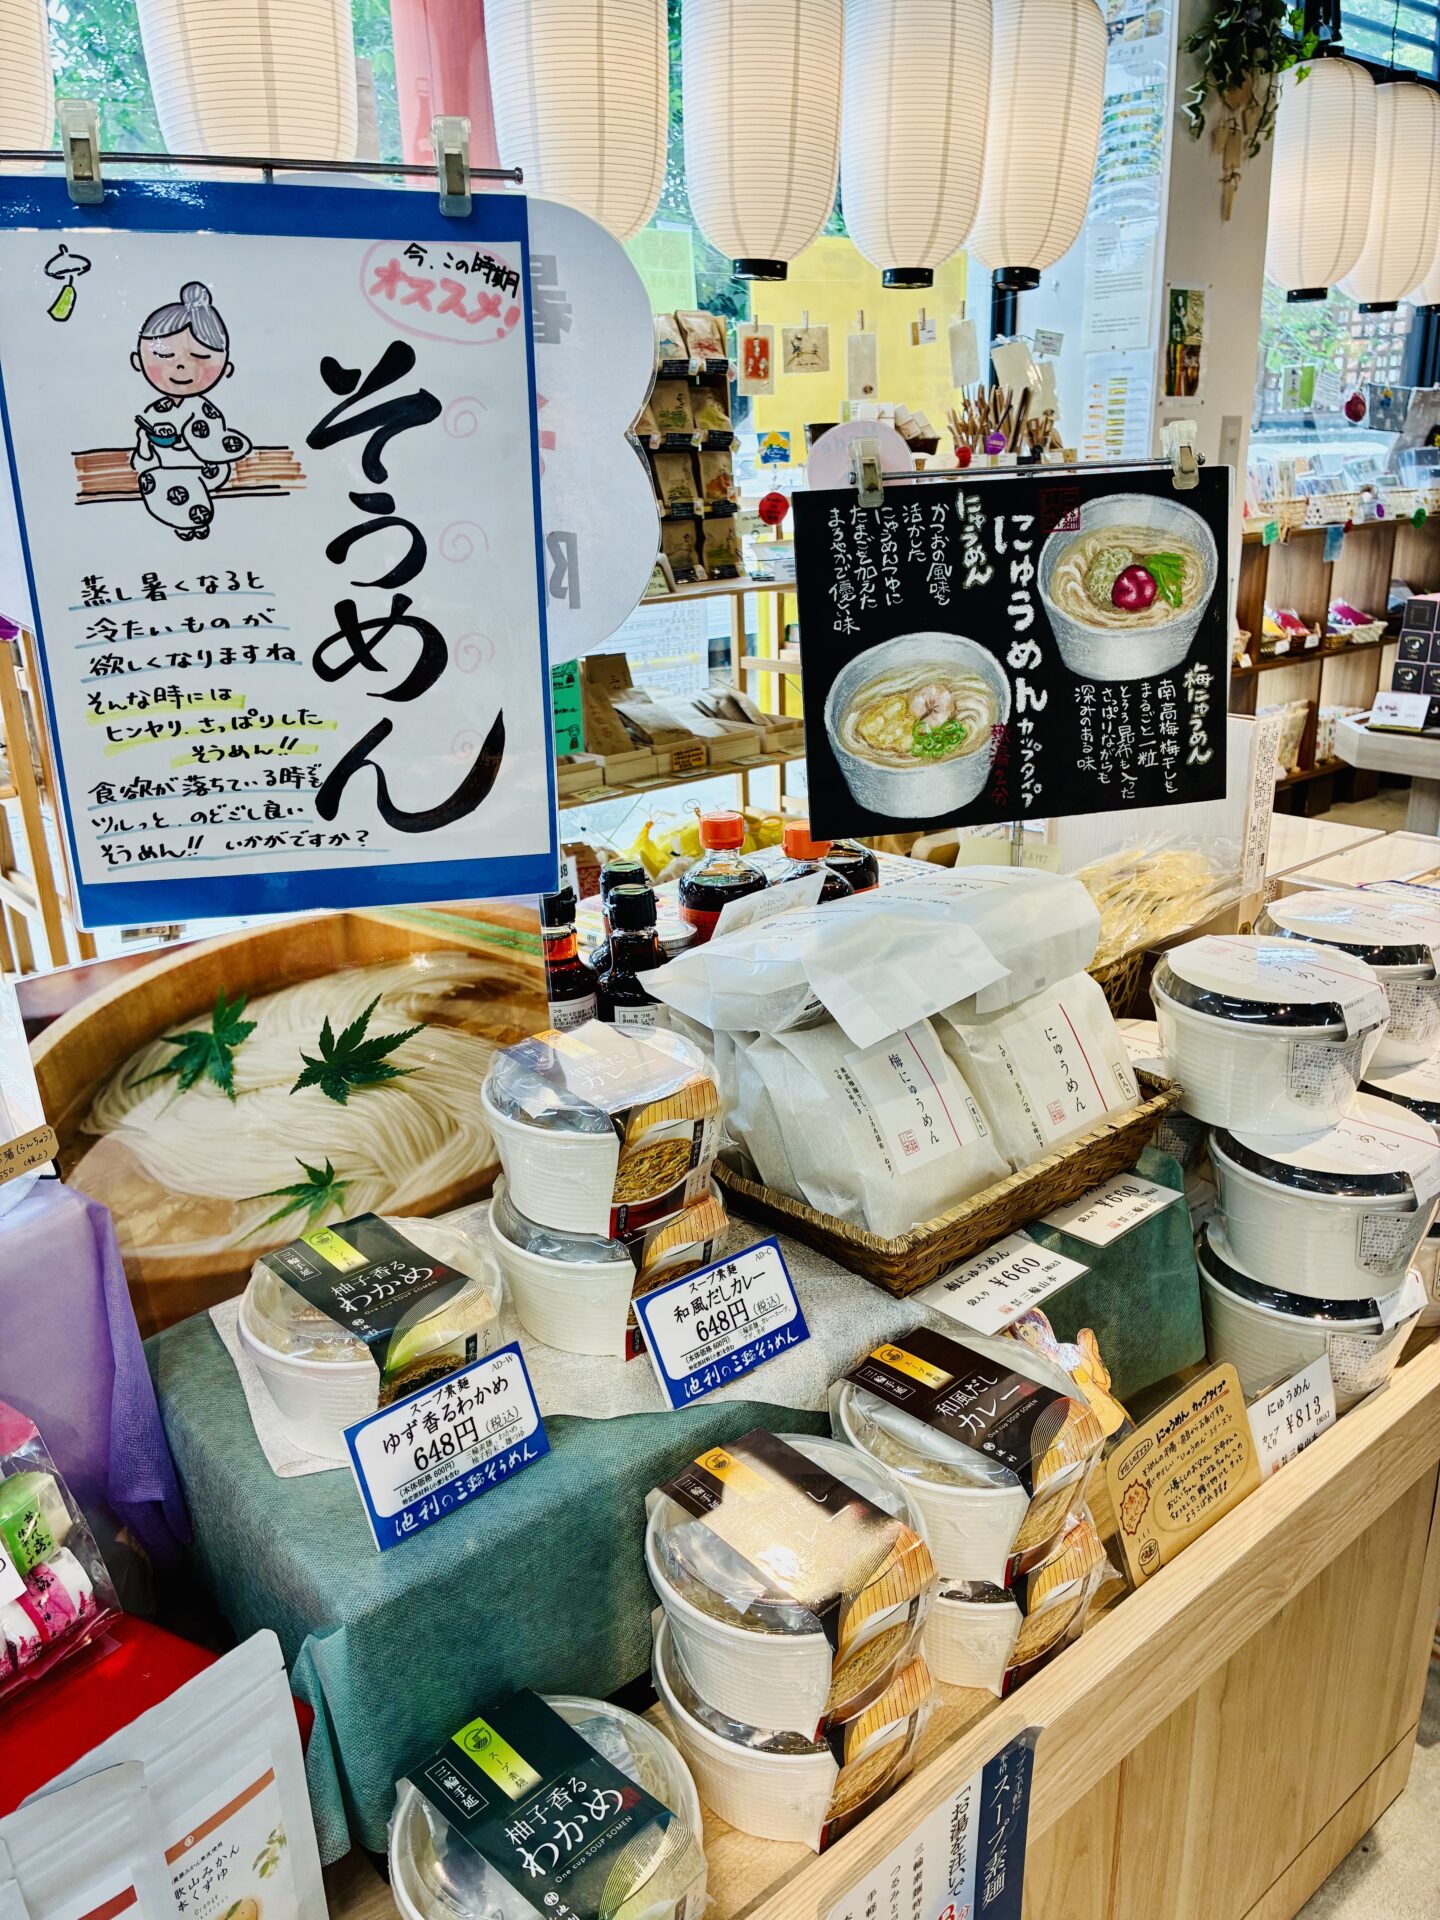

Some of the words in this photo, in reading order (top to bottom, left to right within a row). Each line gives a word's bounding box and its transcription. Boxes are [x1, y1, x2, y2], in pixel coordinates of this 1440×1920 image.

[850, 504, 878, 609] たまごを加えた
[874, 506, 903, 605] にゅうめんつゆに
[902, 503, 926, 562] 活かした
[926, 503, 952, 605] かつおの風味を
[957, 489, 994, 589] にゅうめん
[81, 571, 265, 607] 蒸し暑くなると
[306, 340, 505, 833] そうめん
[828, 508, 860, 634] まろやかで優しい味
[85, 608, 276, 642] 冷たいものが
[994, 516, 1047, 713] にゅうめん
[90, 643, 296, 677] 欲しくなりますね
[87, 685, 232, 716] そんな時には
[1075, 684, 1097, 771] 深みのある味
[1137, 682, 1158, 767] まるごと一粒
[1183, 662, 1215, 766] 梅にゅうめん
[1016, 718, 1042, 808] カップタイプ
[1097, 688, 1119, 784] さっぱりながらも
[1115, 686, 1138, 799] とろろ昆布も入った
[89, 764, 324, 804] 食欲が落ちている時でも
[226, 830, 370, 852] いかがですか?
[888, 1054, 940, 1145] 梅にゅうめん
[1044, 1027, 1085, 1112] にゅうめん
[1094, 1184, 1140, 1210] ¥660
[332, 1261, 406, 1298] 柚子香る
[689, 1262, 738, 1294] スープ素麺
[755, 1247, 773, 1262] AD-C
[943, 1250, 1010, 1293] 梅にゅうめん
[988, 1256, 1041, 1289] ¥660
[340, 1267, 434, 1313] わかめ
[674, 1271, 766, 1324] 和風だしカレー
[696, 1298, 750, 1342] 648円
[753, 1293, 781, 1316] (税込)
[491, 1353, 515, 1373] AD-W
[684, 1326, 800, 1398] 池利の三輪そうめん
[382, 1375, 509, 1455] ゆず香るわかめ
[410, 1375, 471, 1416] スープ素麺
[935, 1374, 998, 1417] 和風だし
[957, 1384, 1021, 1436] カレー
[1156, 1410, 1190, 1444] にゅうめん
[1191, 1379, 1226, 1412] カップタイプ
[1267, 1378, 1310, 1416] にゅうめん
[1286, 1395, 1321, 1434] ¥813
[413, 1417, 480, 1471] 648円
[485, 1405, 519, 1434] (税込)
[395, 1441, 538, 1537] 池利の三輪そうめん
[434, 1765, 480, 1811] 三輪手延
[489, 1751, 529, 1790] スープ素麺
[504, 1776, 588, 1846] 柚子香る
[515, 1787, 624, 1879] わかめ
[554, 1867, 572, 1884] One
[585, 1837, 607, 1858] SOUP
[605, 1815, 633, 1840] SOMEN
[982, 1774, 1011, 1911] スープ素麺
